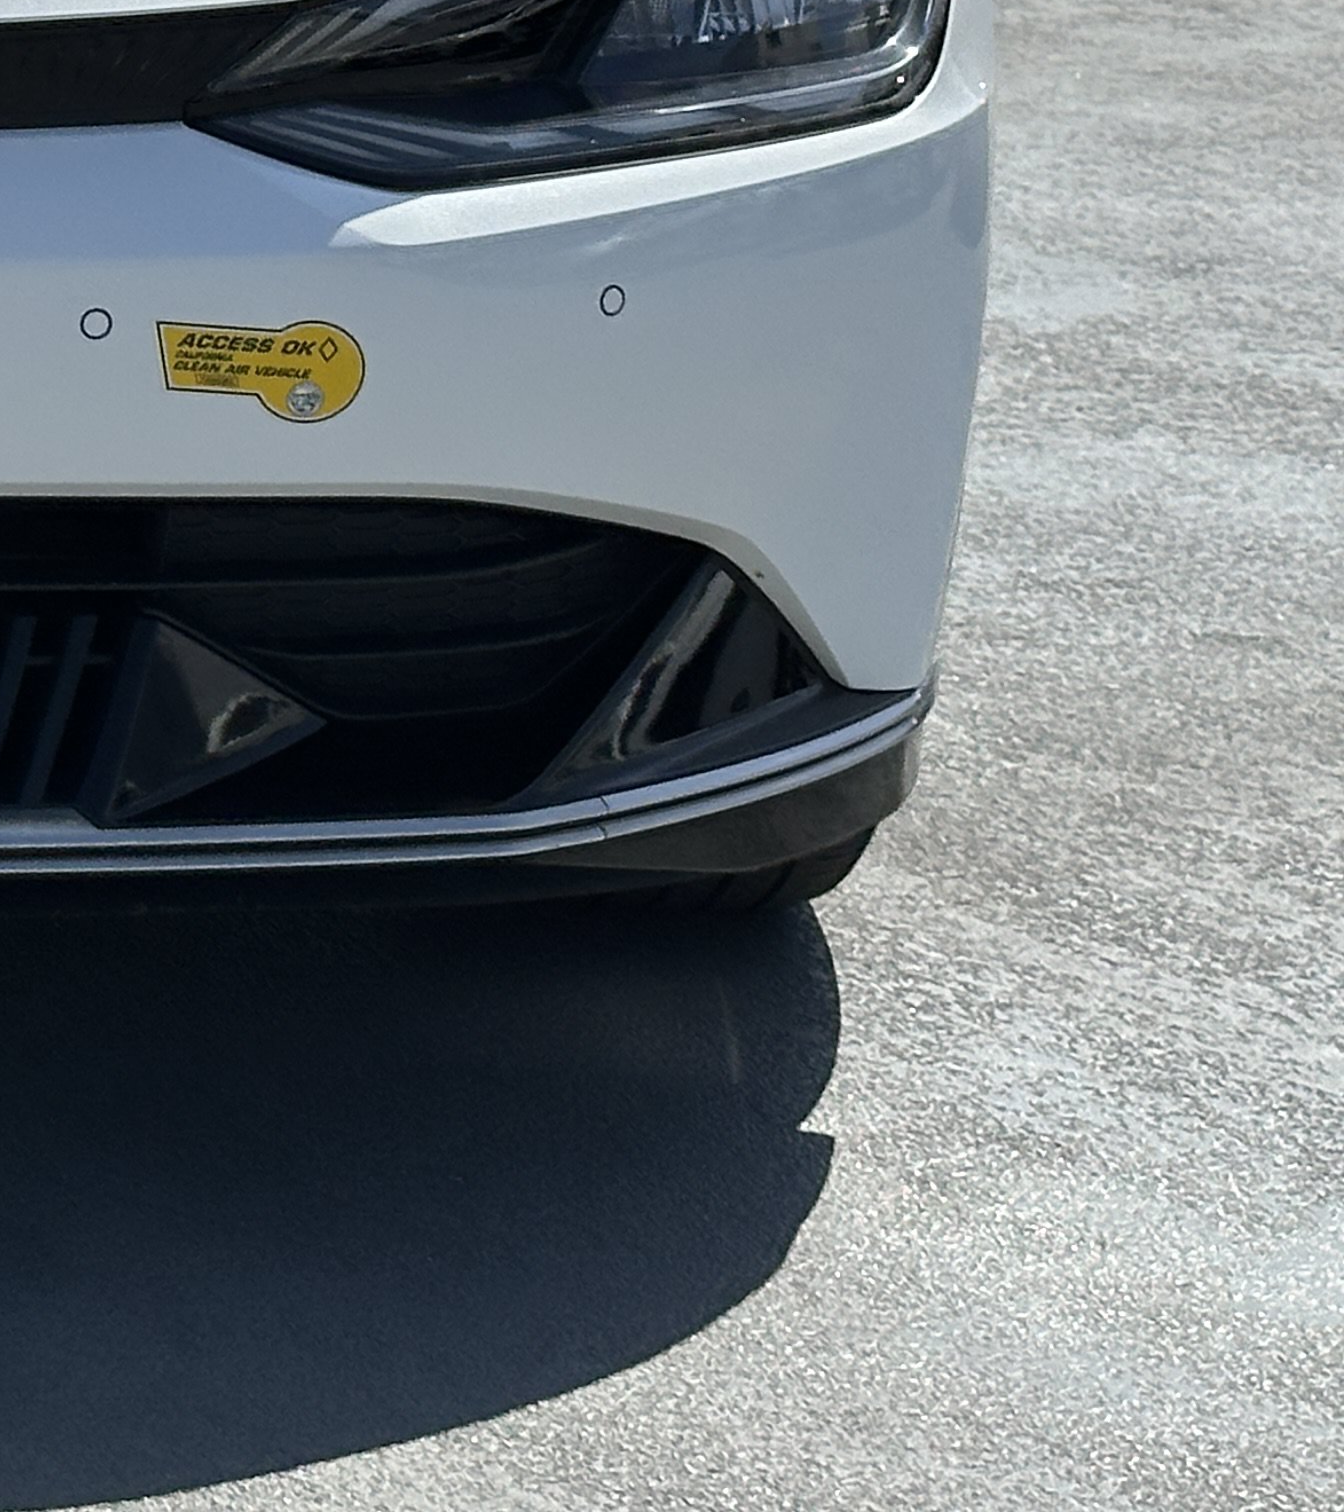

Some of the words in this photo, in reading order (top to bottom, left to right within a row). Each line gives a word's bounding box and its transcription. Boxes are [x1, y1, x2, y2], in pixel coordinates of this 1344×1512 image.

[177, 332, 275, 354] ACCESS
[281, 339, 317, 356] OK
[173, 360, 221, 374] CLEAN
[224, 363, 251, 376] AIR
[255, 367, 312, 380] VEHICLE
